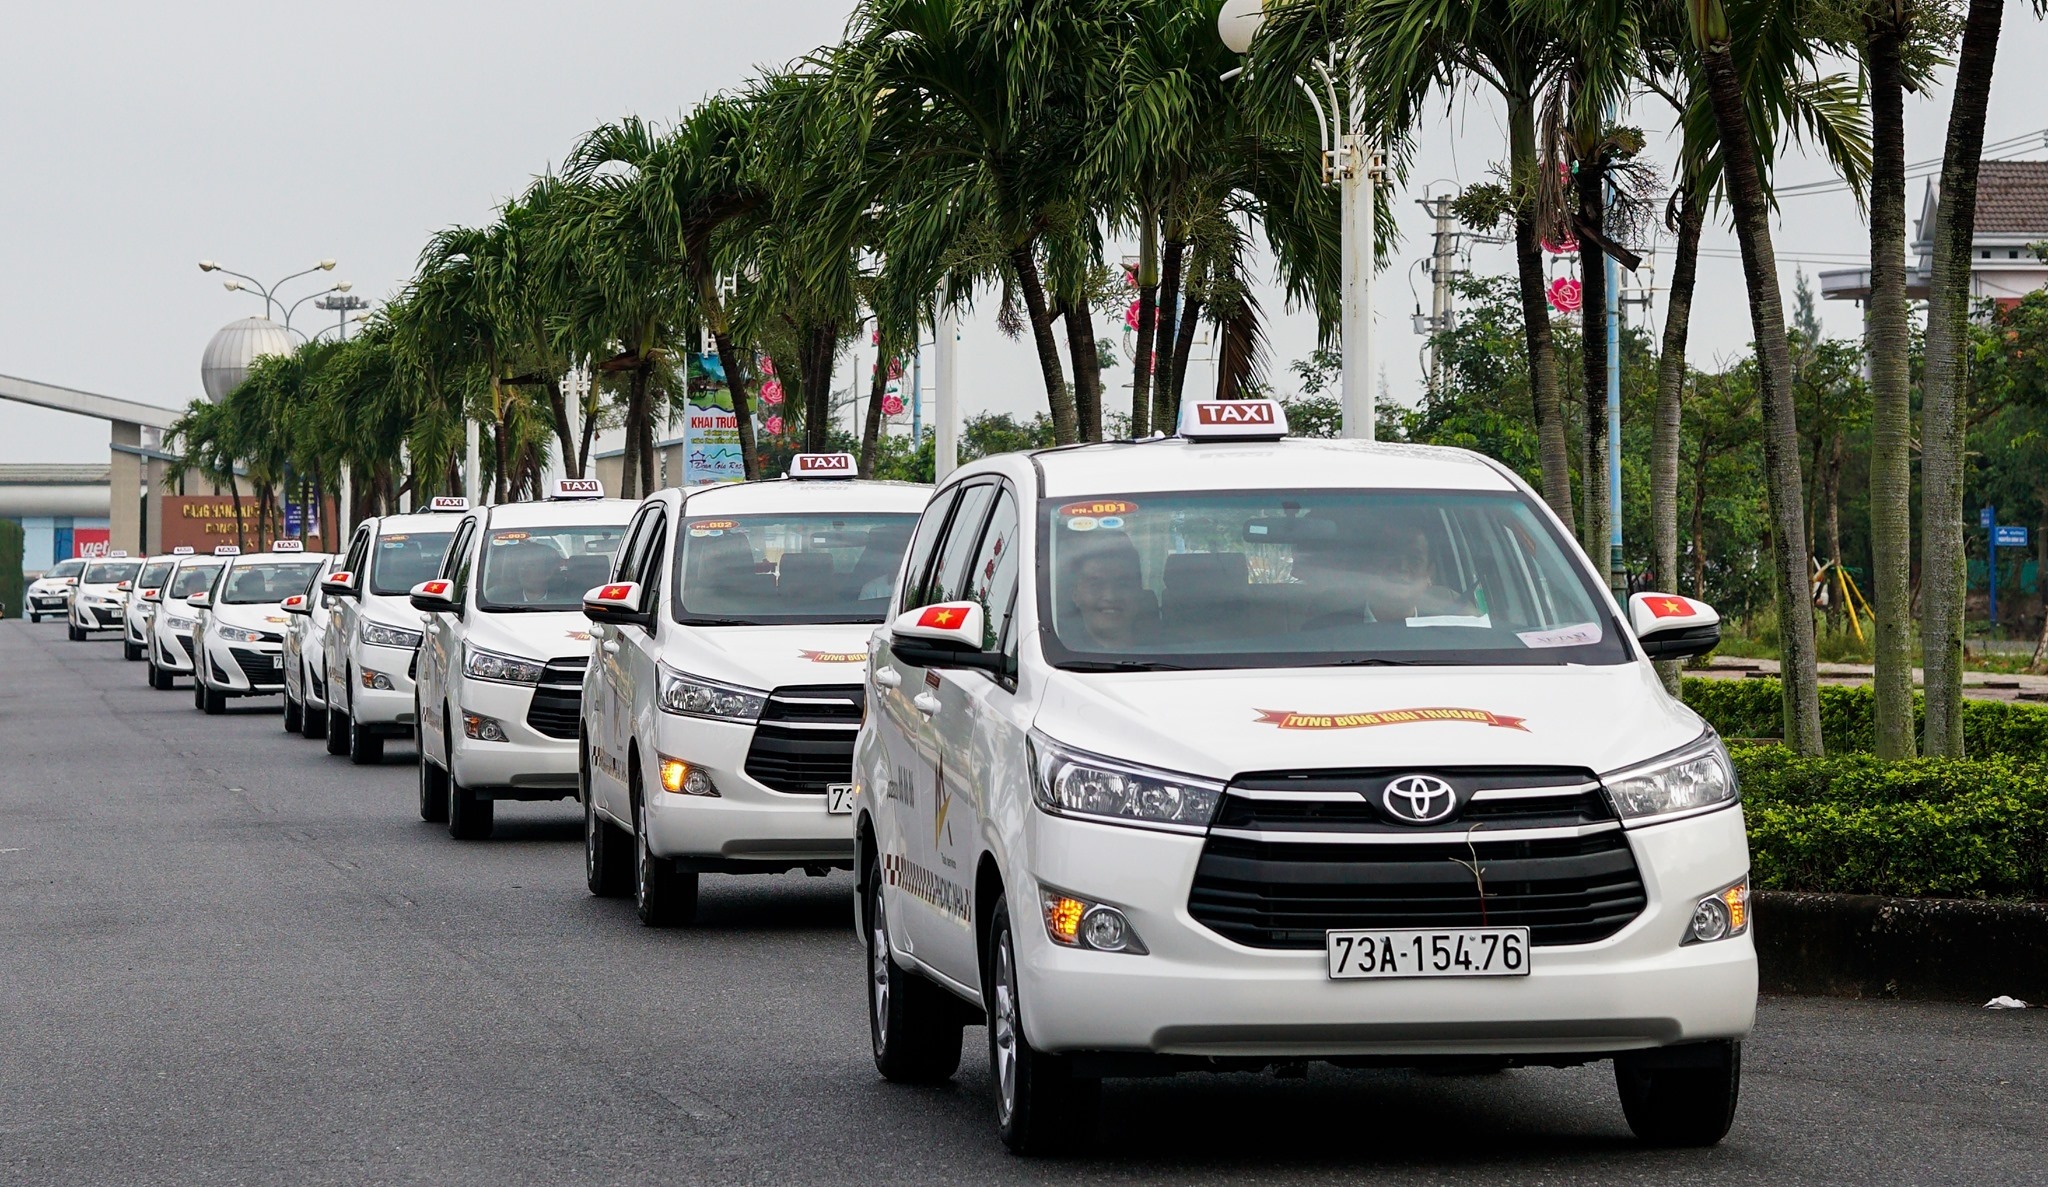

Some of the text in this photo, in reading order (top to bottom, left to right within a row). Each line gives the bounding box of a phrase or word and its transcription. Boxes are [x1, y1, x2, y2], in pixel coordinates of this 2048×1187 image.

[1203, 405, 1269, 422] TAXI
[691, 417, 713, 428] KHAI
[803, 457, 846, 468] TAXI
[562, 481, 597, 491] TAXI
[1377, 711, 1420, 722] KHAI
[1336, 934, 1522, 972] 73A-154.76
